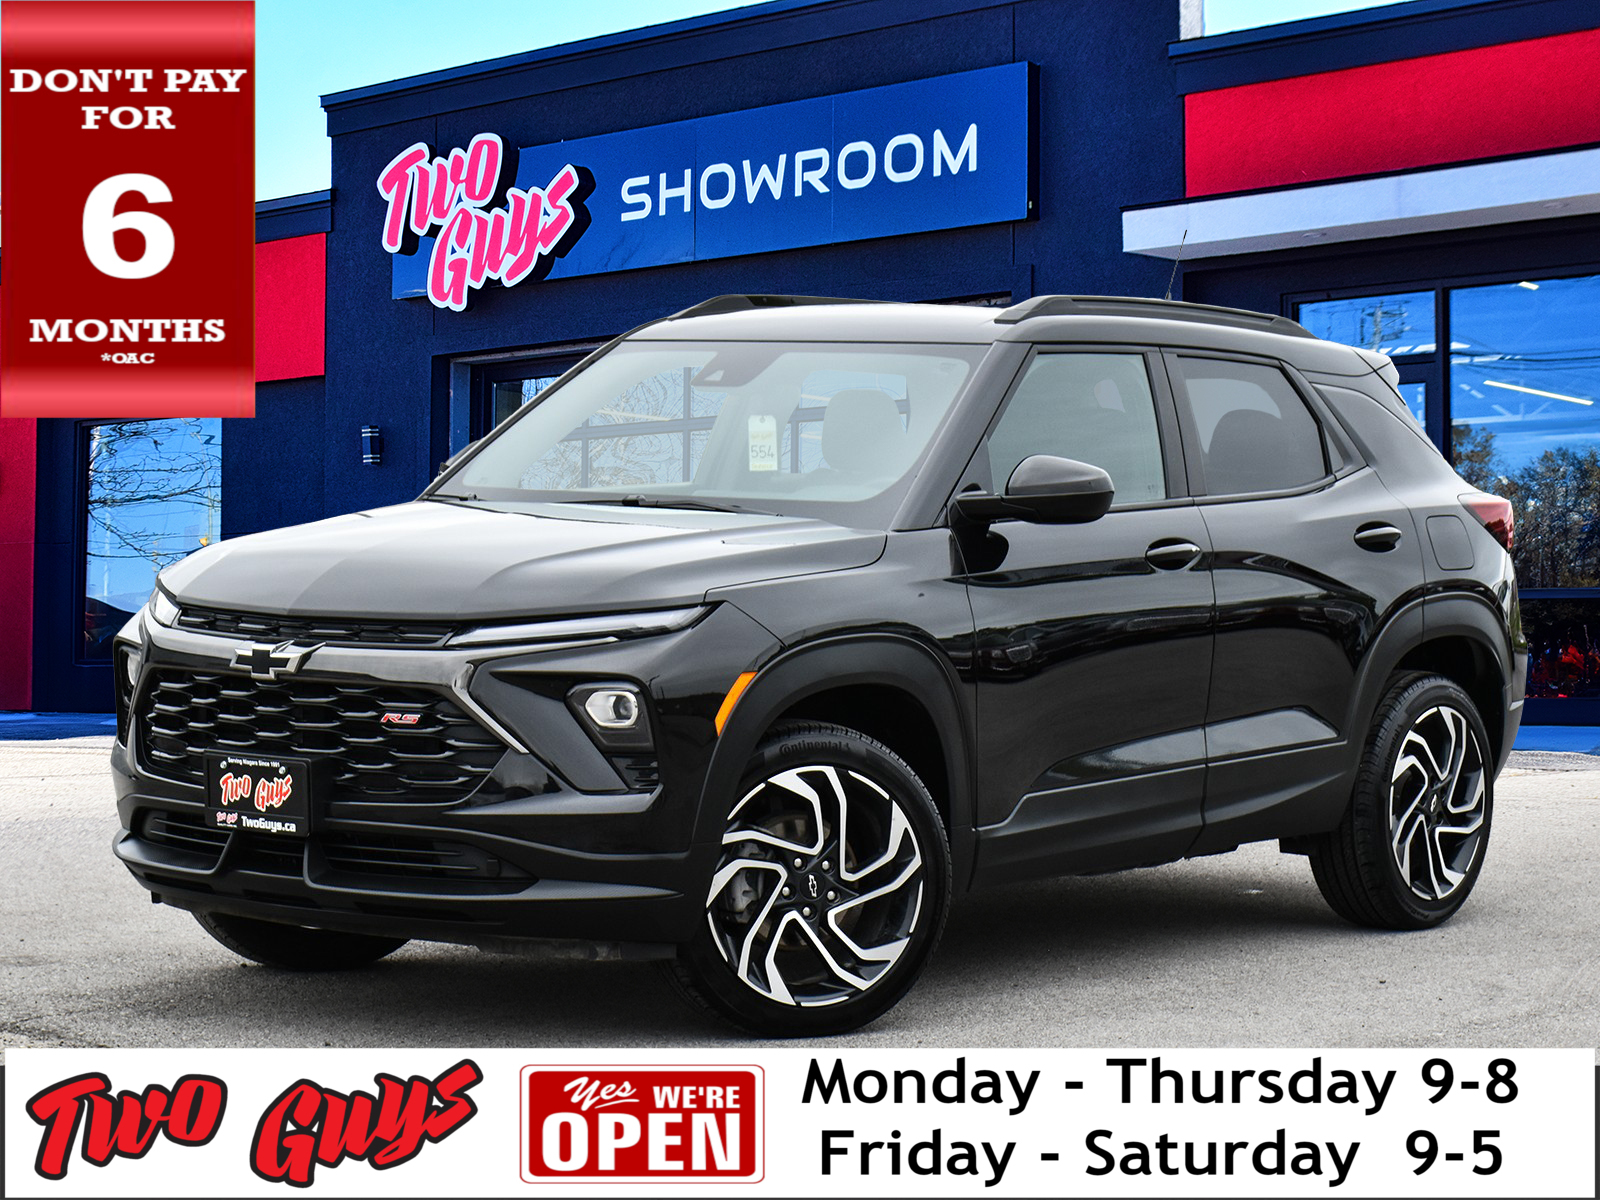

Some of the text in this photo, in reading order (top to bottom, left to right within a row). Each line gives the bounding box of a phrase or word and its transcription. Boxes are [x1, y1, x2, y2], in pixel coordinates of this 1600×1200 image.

[620, 122, 978, 222] SHOWROOM
[750, 444, 775, 459] 554
[380, 712, 420, 724] RS
[779, 740, 842, 755] Continental
[241, 815, 297, 833] TwoGuys.ca
